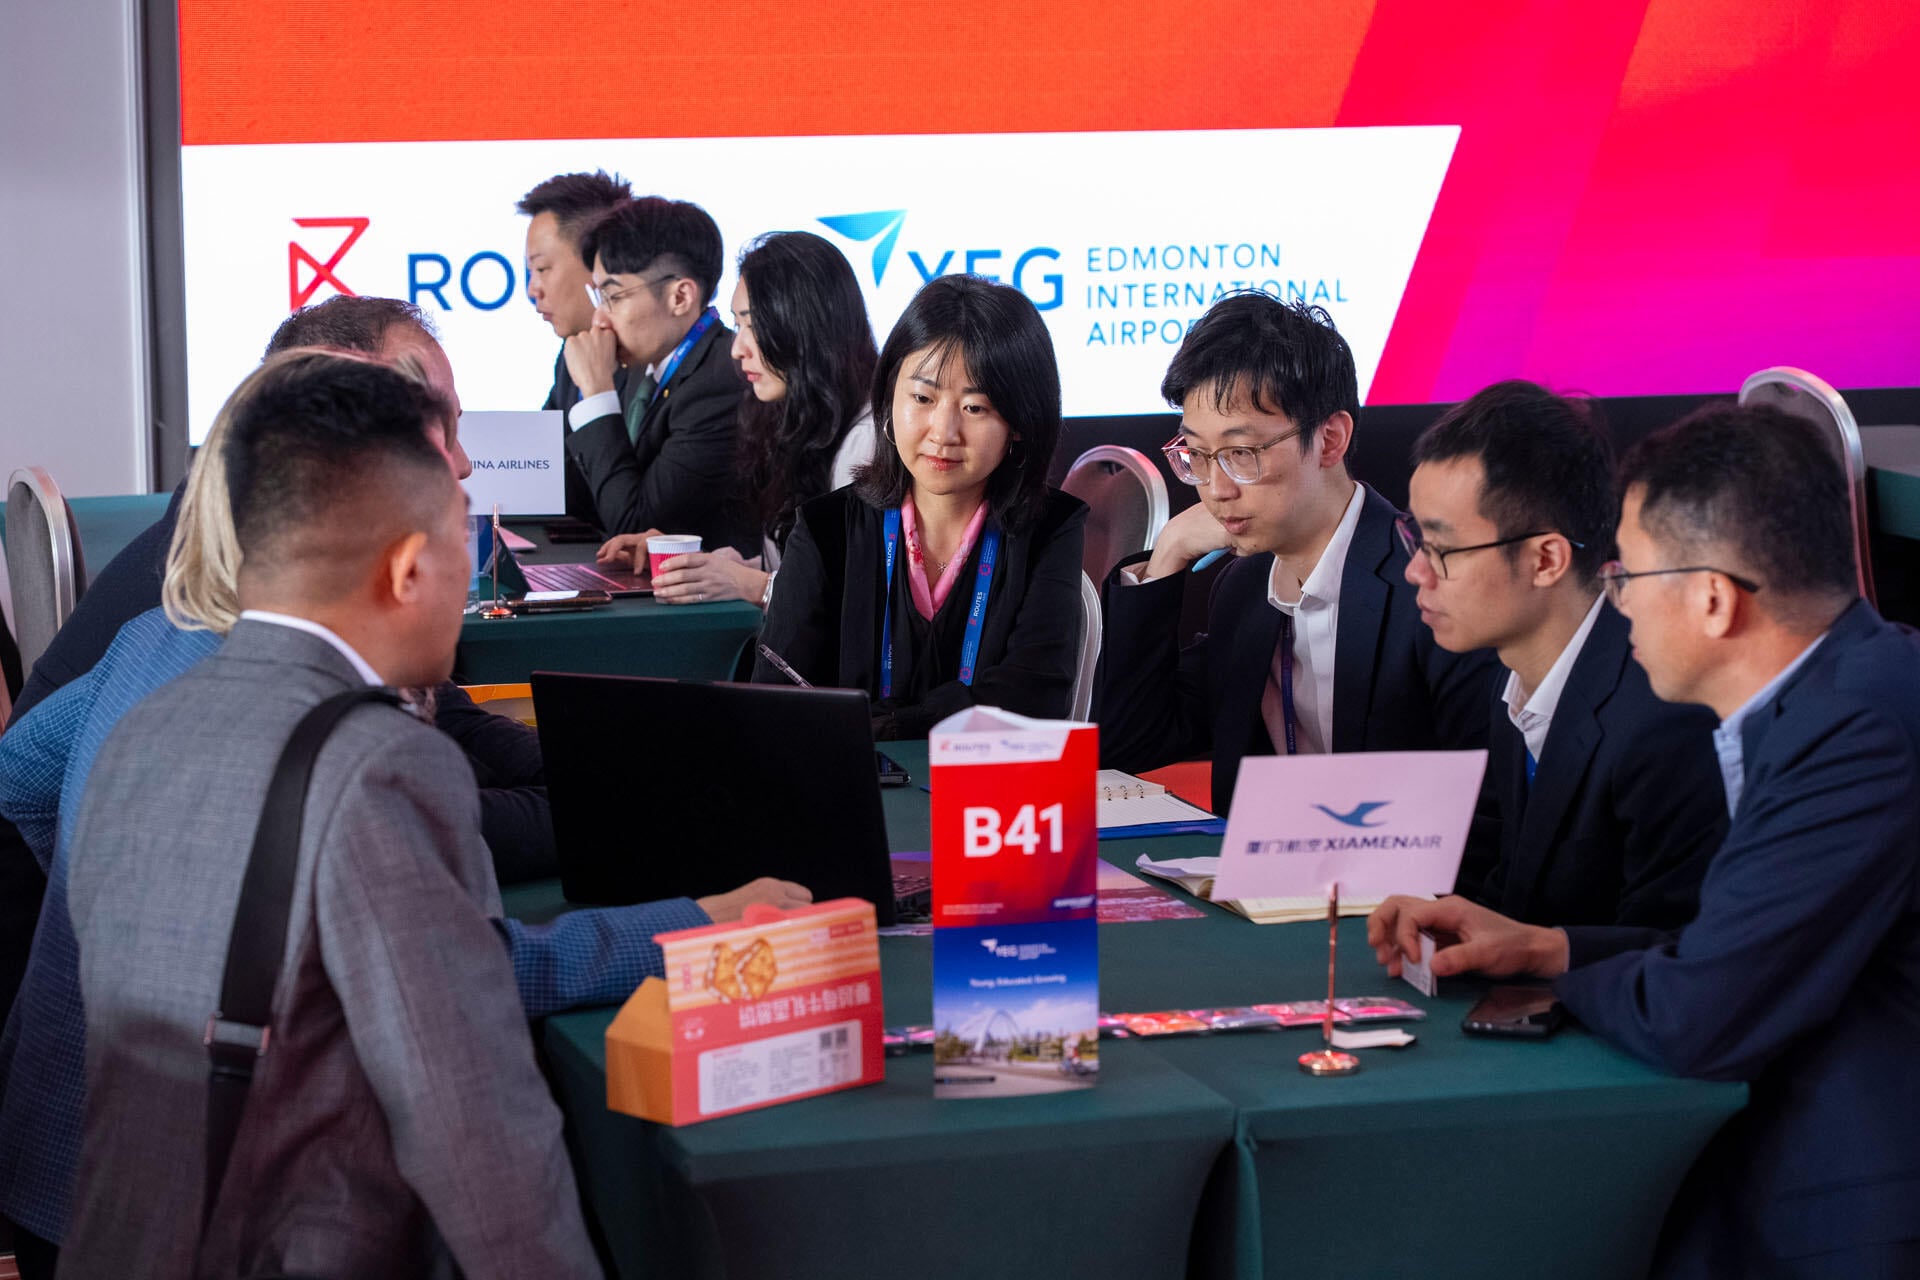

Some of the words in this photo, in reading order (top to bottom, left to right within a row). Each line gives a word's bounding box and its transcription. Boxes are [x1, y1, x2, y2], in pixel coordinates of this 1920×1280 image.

[1087, 243, 1280, 272] EDMONTON
[407, 250, 537, 311] RO
[470, 459, 495, 470] INA
[497, 459, 550, 470] AIRLINES
[974, 591, 983, 617] ROUTES
[963, 803, 1064, 858] B41
[1323, 835, 1443, 852] XIAMENAIR
